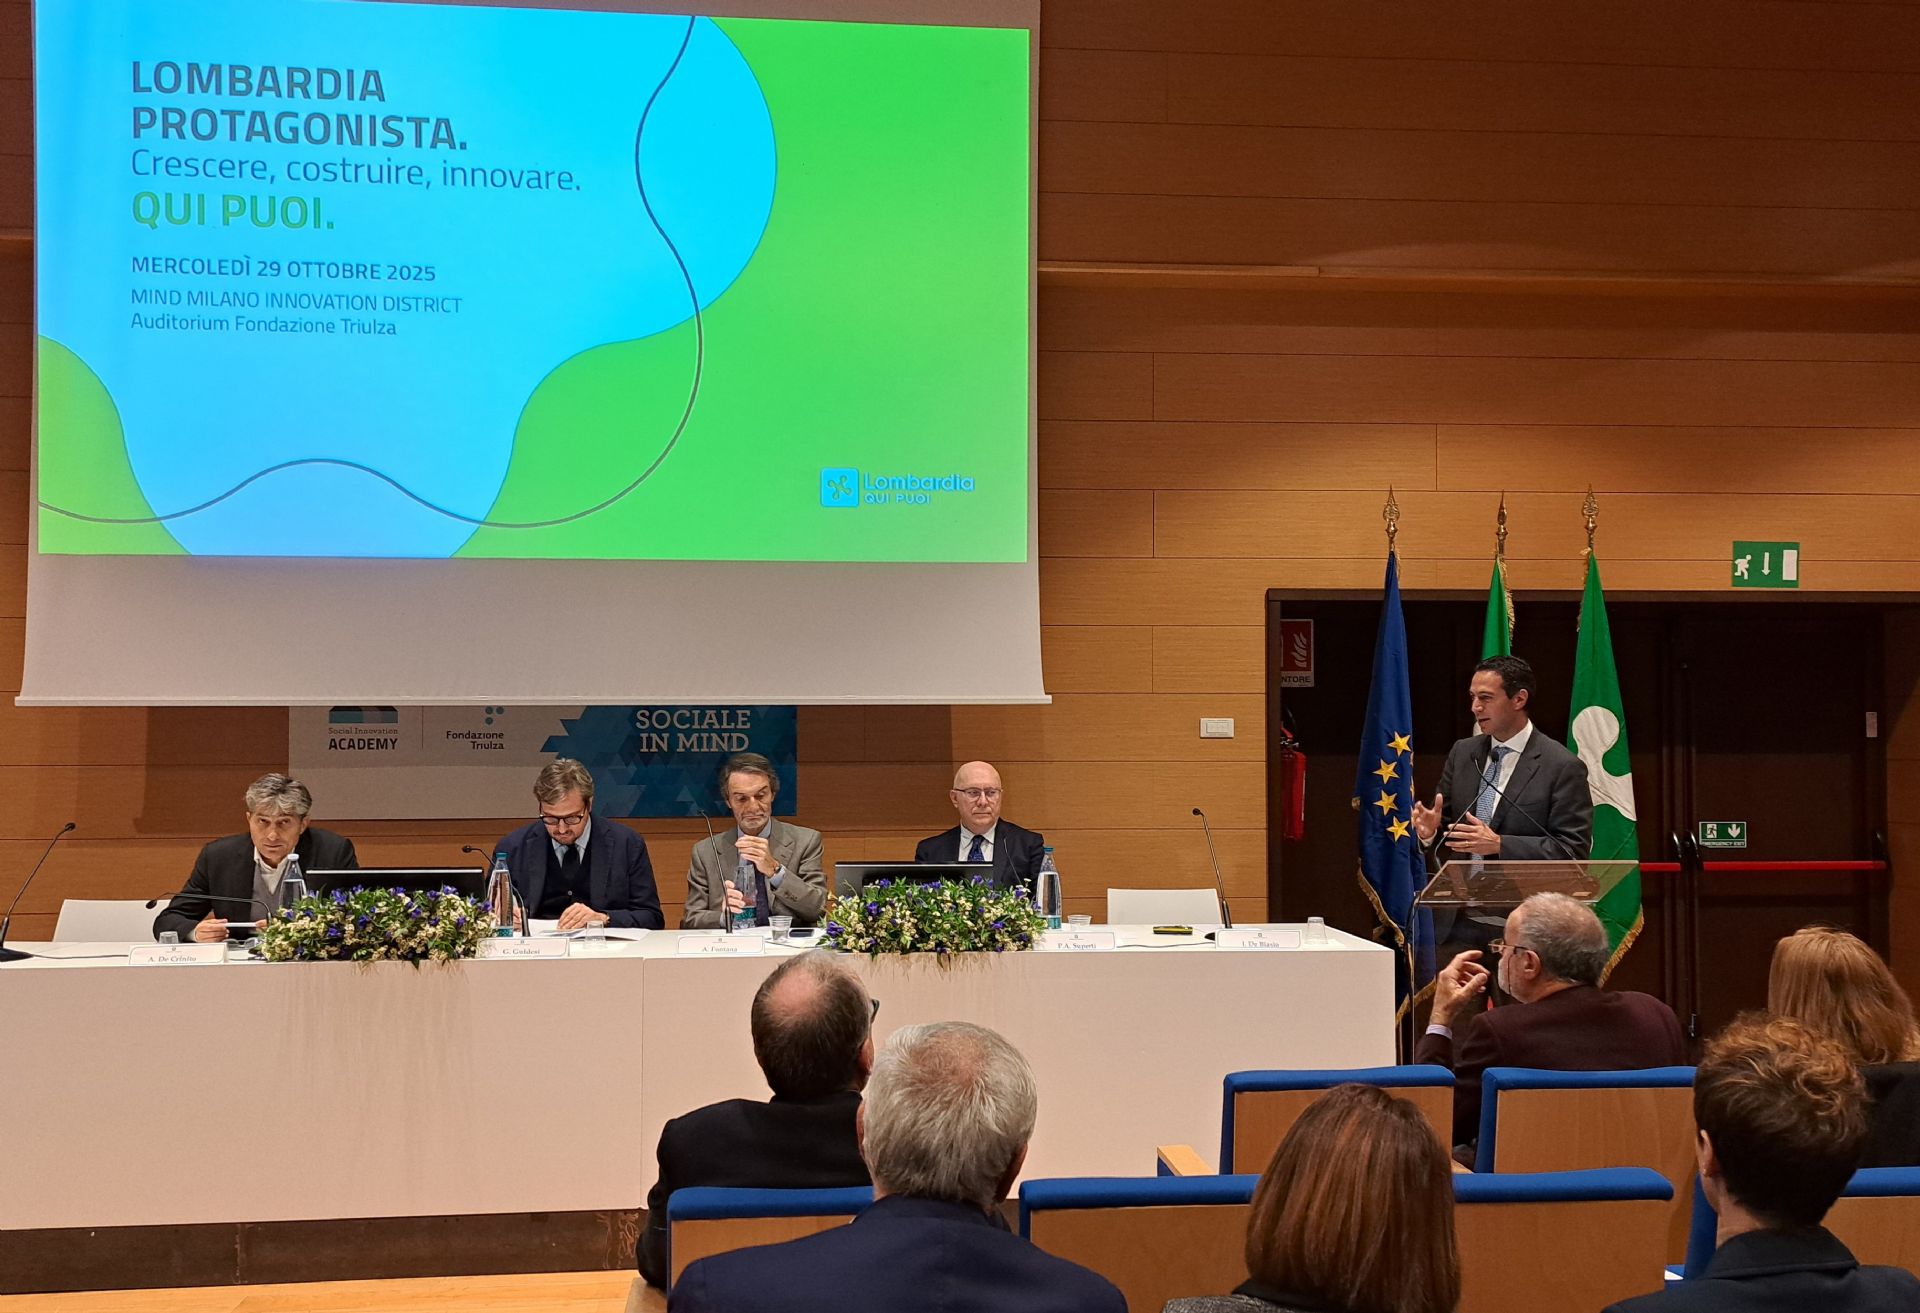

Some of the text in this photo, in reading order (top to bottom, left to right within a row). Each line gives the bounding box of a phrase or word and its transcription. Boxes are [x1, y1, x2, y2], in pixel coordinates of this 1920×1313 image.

[132, 60, 386, 102] LOMBARDIA
[132, 106, 467, 151] PROTAGONISTA.
[131, 148, 581, 192] Crescere, costruire, innovare.
[132, 191, 335, 230] QUI PUOI.
[131, 254, 436, 282] MERCOLEDÌ 29 OTTOBRE 2025
[131, 288, 463, 314] MIND MILANO INNOVATION DISTRICT
[130, 312, 398, 336] Auditorium Fondazione Triulza
[864, 473, 974, 491] Lombardia
[863, 492, 932, 506] QUI PUOI
[635, 709, 751, 730] SOCIALE
[328, 726, 399, 735] Social Innovation
[446, 730, 504, 740] Fondazione
[328, 737, 399, 751] ACADEMY
[470, 741, 505, 750] Triulza
[640, 732, 750, 753] IN MIND
